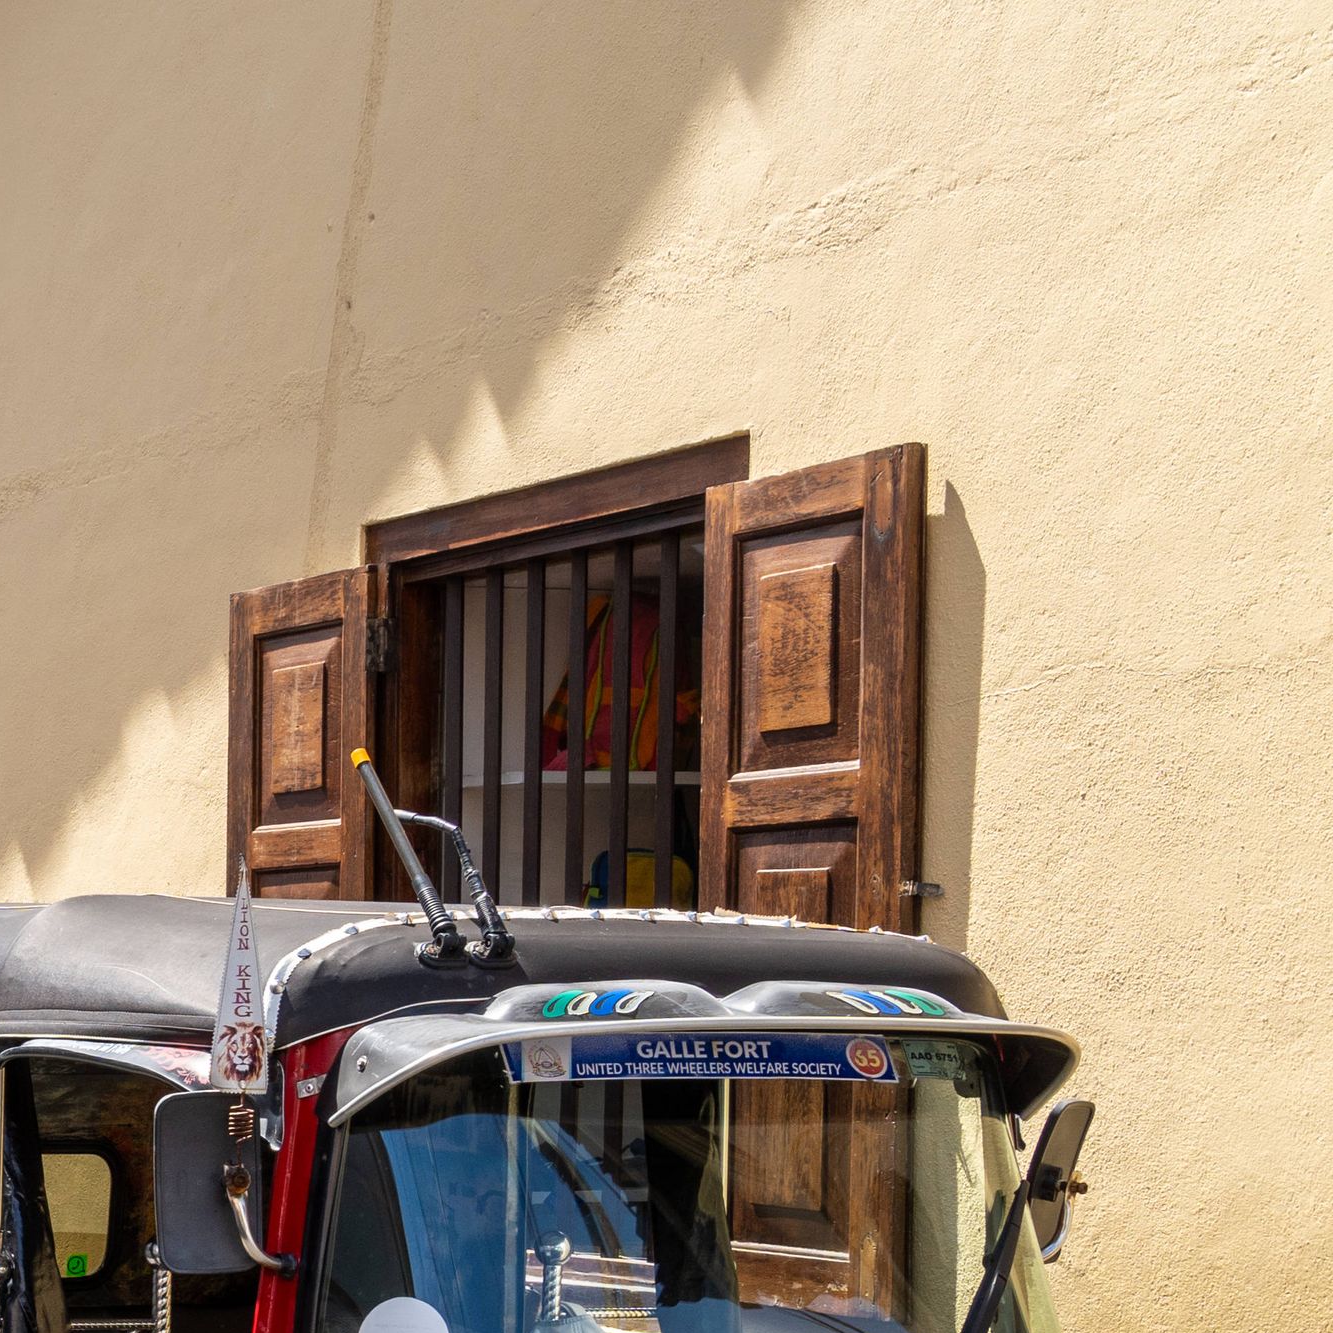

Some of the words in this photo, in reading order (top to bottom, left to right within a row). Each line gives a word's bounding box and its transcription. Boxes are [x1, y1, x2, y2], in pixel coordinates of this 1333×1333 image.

[237, 898, 250, 951] LION
[233, 965, 253, 1018] KING
[636, 1040, 709, 1059] GALLE
[713, 1040, 772, 1059] FORT
[576, 1062, 623, 1076] UNITED
[625, 1062, 665, 1075] THREE
[666, 1062, 732, 1075] WHEELERS
[733, 1062, 791, 1075] WELFARE
[792, 1062, 842, 1076] SOCIETY
